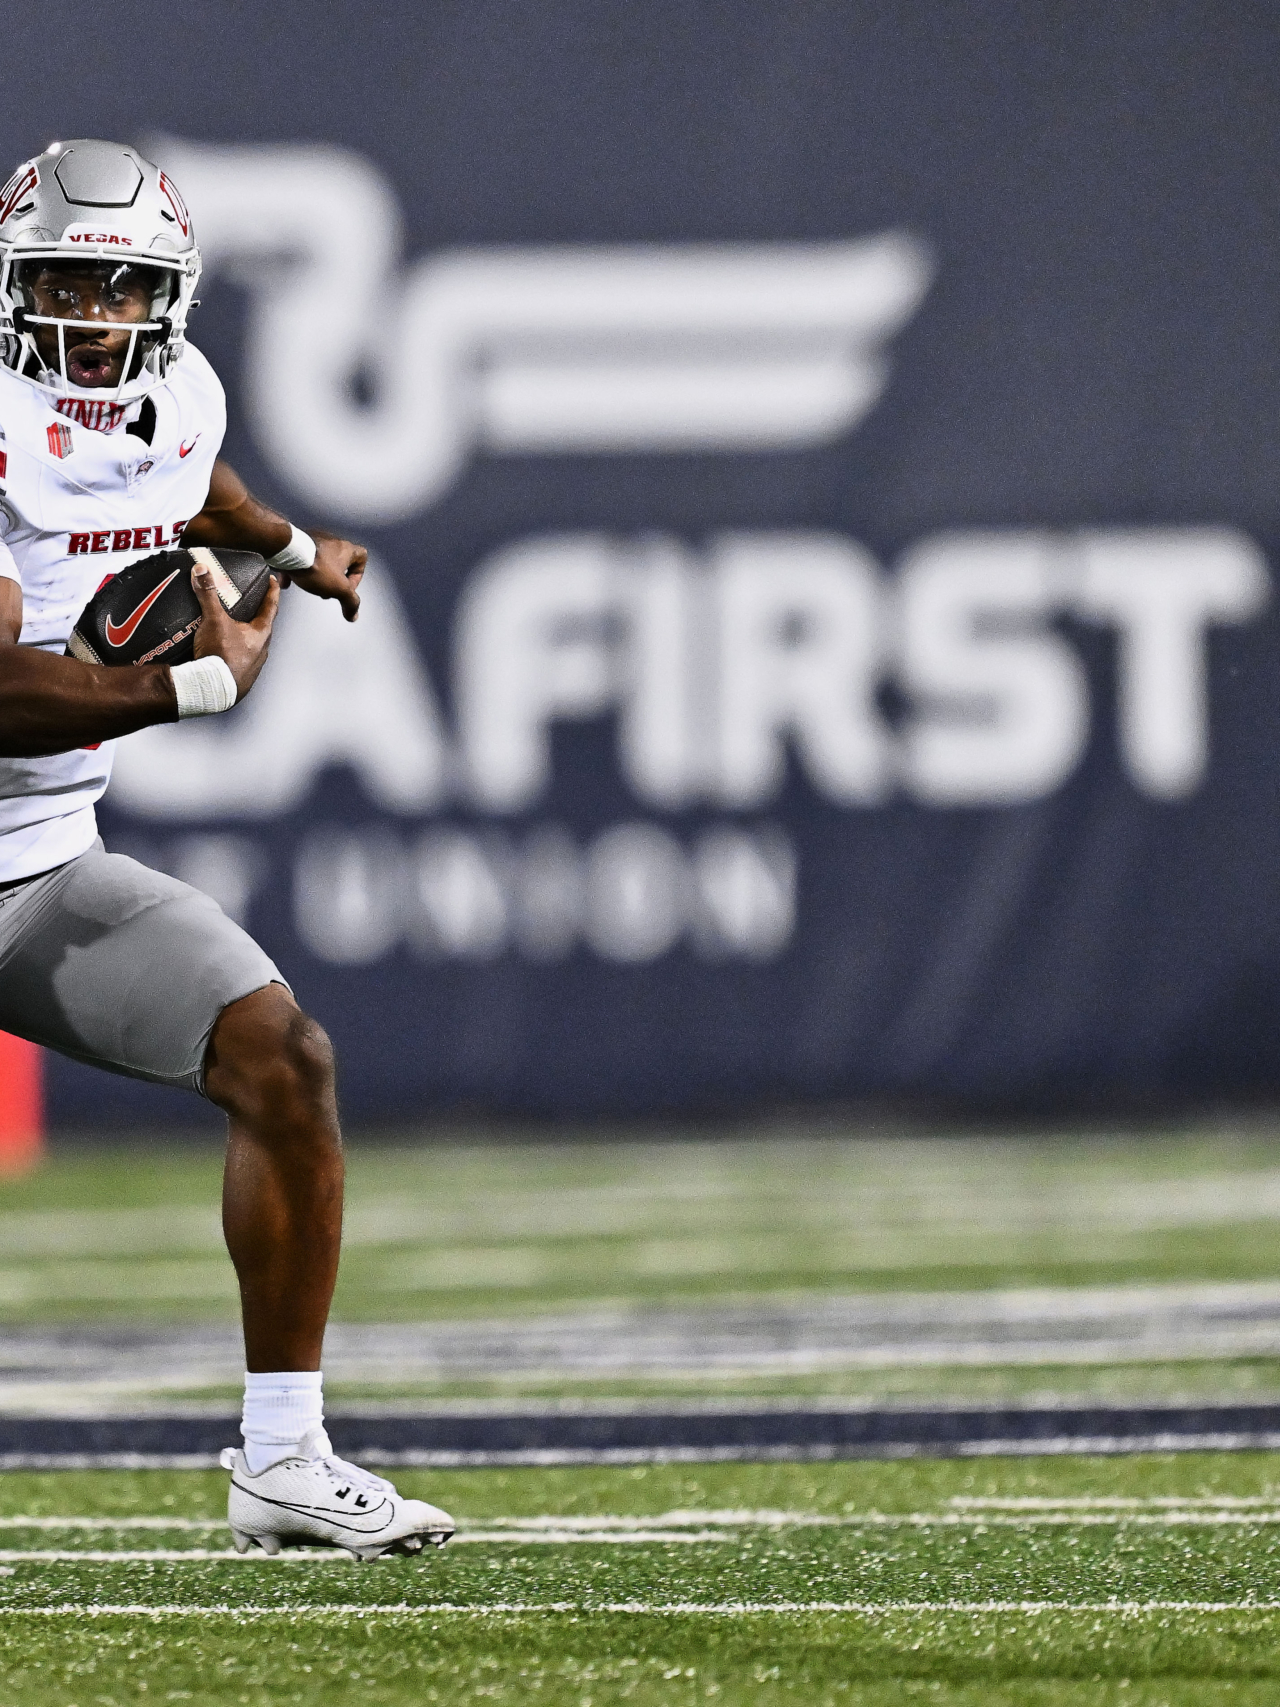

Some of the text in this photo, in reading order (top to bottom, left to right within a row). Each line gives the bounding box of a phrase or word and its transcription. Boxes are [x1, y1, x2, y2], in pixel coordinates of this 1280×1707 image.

[68, 233, 133, 246] VEGAS
[67, 520, 189, 555] REBELS
[133, 639, 174, 666] VAPOR
[455, 528, 1265, 808] FIRST
